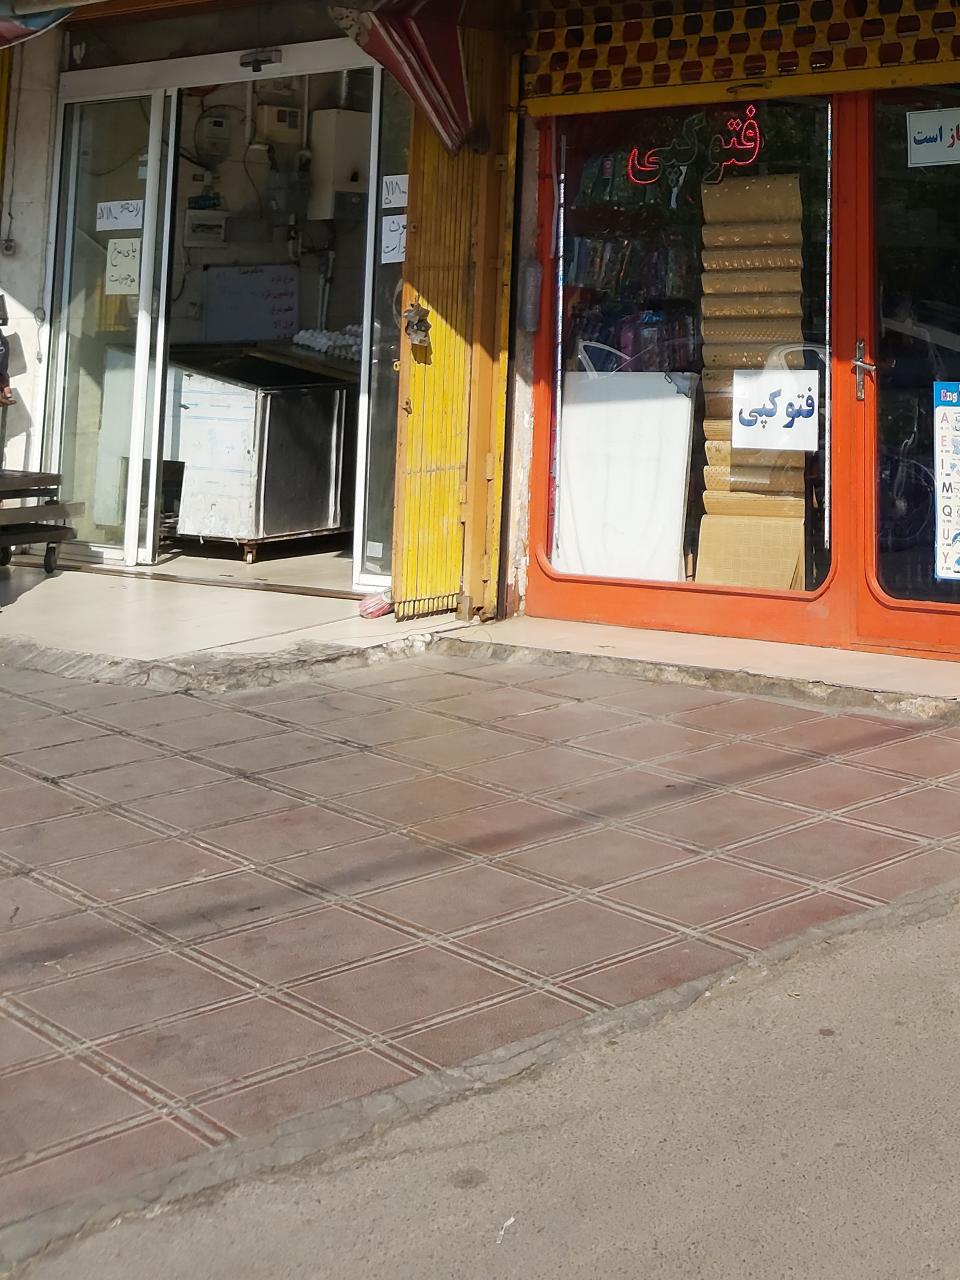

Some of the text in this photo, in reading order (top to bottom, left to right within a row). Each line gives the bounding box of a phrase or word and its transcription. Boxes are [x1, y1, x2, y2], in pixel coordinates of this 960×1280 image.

[913, 125, 943, 145] است
[940, 412, 949, 424] A
[942, 482, 953, 493] M
[942, 505, 952, 517] Q
[942, 528, 950, 540] U
[942, 551, 949, 564] Y
